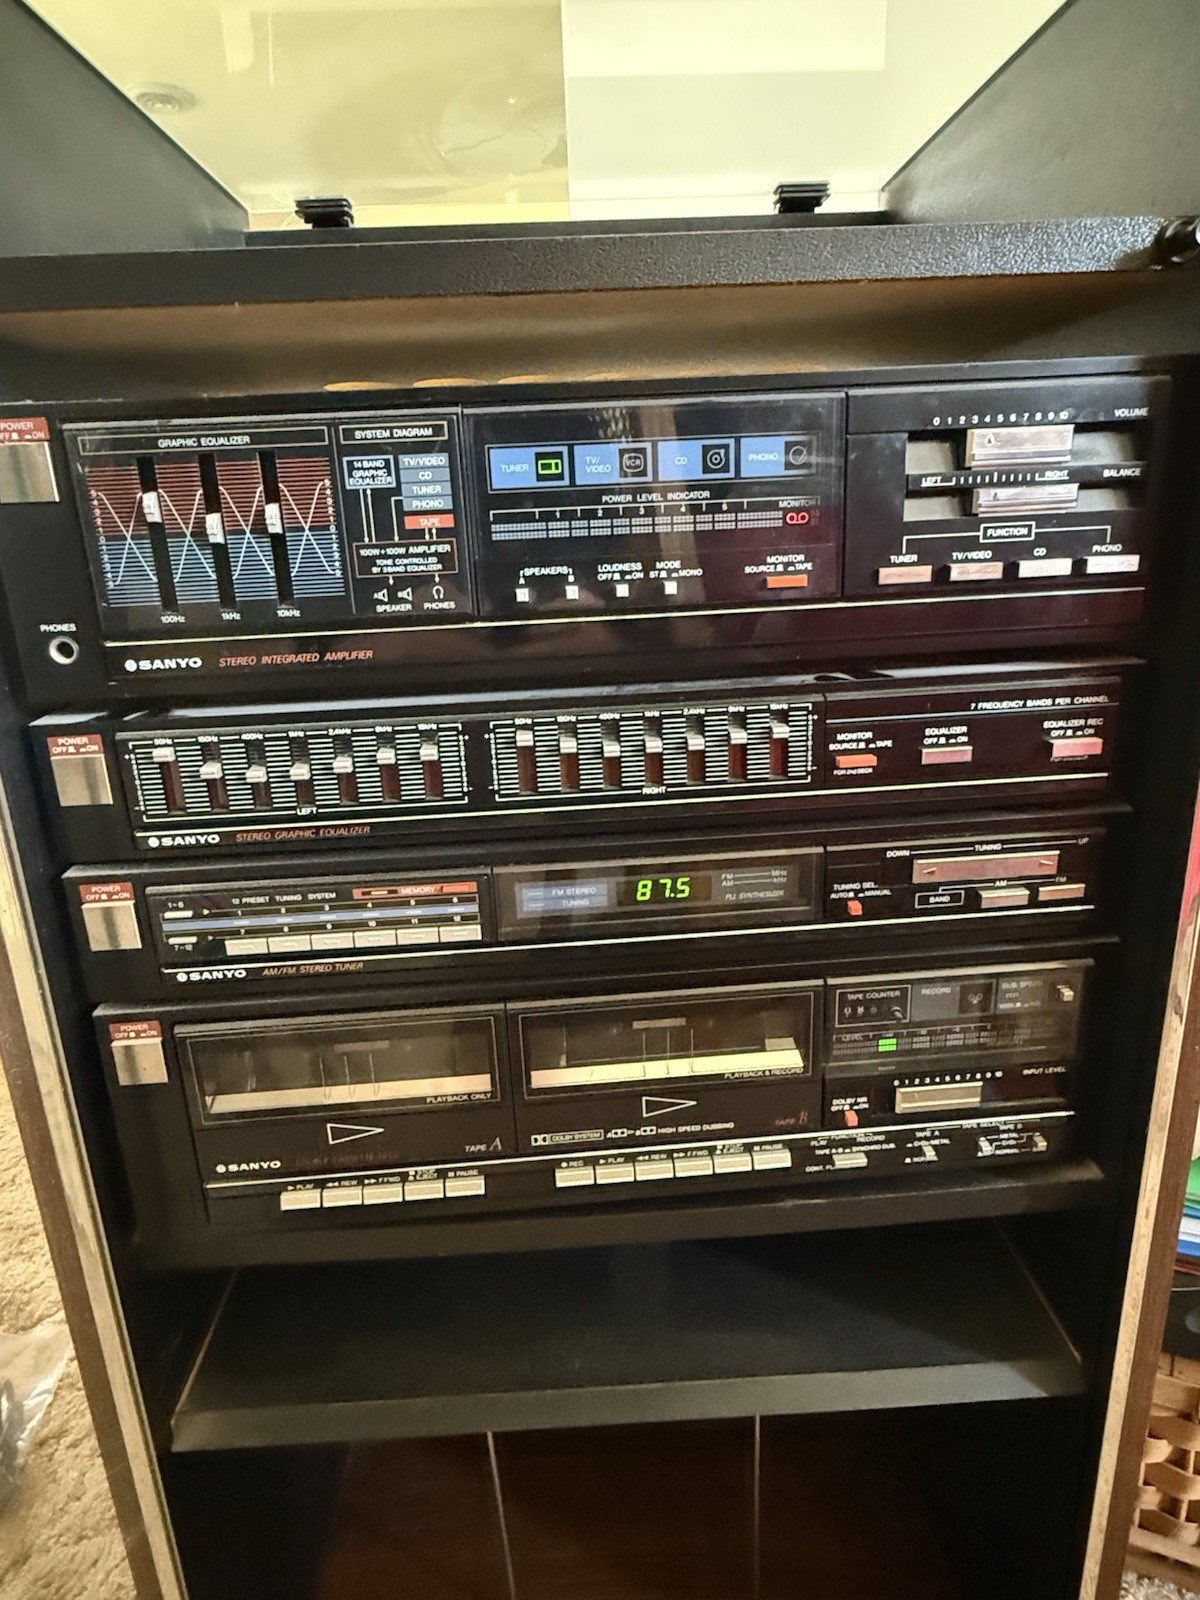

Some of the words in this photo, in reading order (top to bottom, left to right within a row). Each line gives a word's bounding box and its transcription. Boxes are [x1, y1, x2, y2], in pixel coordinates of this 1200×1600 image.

[1114, 407, 1149, 418] VOLUME
[934, 416, 940, 426] 0
[960, 416, 966, 425] 2
[972, 415, 978, 424] 3
[984, 414, 991, 424] 4
[996, 414, 1004, 424] 5
[1010, 413, 1016, 422] 6
[1022, 412, 1029, 422] 7
[1035, 412, 1042, 421] 8
[1048, 412, 1054, 420] 9
[1059, 411, 1069, 420] 10
[0, 422, 34, 431] POWER
[0, 432, 10, 440] FF
[32, 431, 46, 440] ON
[354, 429, 390, 440] SYSTEM
[393, 426, 433, 438] DIAGRAM
[158, 437, 198, 448] GRAPHIC
[200, 435, 250, 447] EQUALIZER
[403, 456, 446, 466] TV/VIDEO
[586, 456, 600, 466] TV/
[675, 456, 688, 465] CD
[748, 452, 779, 462] PHONO
[362, 460, 386, 468] BAND
[500, 463, 530, 474] TUNER
[586, 464, 612, 474] VIDEO
[352, 469, 388, 478] GRAPHIC
[418, 470, 432, 480] CD
[1102, 468, 1142, 478] BALANCE
[350, 476, 392, 485] EQUALIZER
[922, 476, 942, 486] LEFT
[412, 486, 442, 494] TUNER
[602, 493, 633, 504] POWER
[636, 492, 664, 502] LEVEL
[667, 490, 710, 501] INDICATOR
[412, 499, 444, 508] PHONO
[778, 499, 816, 508] MONITOR
[418, 518, 442, 526] TAPE
[986, 526, 1028, 538] FUNCTION
[408, 544, 451, 554] AMPLIFIER
[1034, 548, 1046, 556] CD
[1092, 544, 1122, 554] PHONO
[766, 554, 806, 564] MONITOR
[890, 554, 918, 564] TUNER
[952, 550, 992, 560] TV/VIDEO
[395, 556, 438, 565] CONTROLLED
[656, 560, 681, 570] MODE
[524, 566, 568, 576] SPEAKERS
[598, 562, 642, 573] LOUDNESS
[744, 564, 776, 574] SOURCE
[795, 562, 813, 572] TAPE
[598, 572, 613, 581] OFF
[632, 571, 644, 580] ON
[650, 570, 660, 579] ST
[678, 568, 703, 578] MONO
[376, 603, 412, 613] SPEAKER
[423, 601, 456, 610] PHONES
[222, 612, 241, 621] 1kHz
[276, 608, 301, 618] 10kHz
[160, 614, 186, 624] 100Hz
[40, 622, 76, 633] PHONES
[138, 656, 202, 670] SANYO
[218, 656, 256, 668] STEREO
[262, 652, 320, 665] INTEGRATED
[324, 649, 374, 662] AMPLIFIER
[978, 699, 1024, 710] FREQUENCY
[1026, 697, 1053, 708] BANDS
[1055, 697, 1072, 706] PER
[1074, 694, 1110, 705] CHANNEL
[1042, 718, 1086, 730] EQUALIZER
[1087, 717, 1104, 726] REC
[836, 731, 873, 741] MONITOR
[925, 726, 968, 736] EQUALIZER
[1050, 730, 1064, 738] OFF
[1084, 728, 1095, 736] ON
[58, 737, 90, 746] POWER
[924, 736, 938, 744] OFF
[956, 735, 968, 744] ON
[52, 746, 66, 754] OFF
[86, 744, 99, 752] ON
[828, 741, 858, 751] SOURCE
[876, 740, 892, 748] TAPE
[642, 786, 667, 795] RIGHT
[296, 807, 317, 816] LEFT
[236, 831, 272, 842] STEREO
[275, 828, 316, 840] GRAPHIC
[318, 825, 370, 838] EQUALIZER
[160, 834, 221, 847] SANYO
[1078, 837, 1090, 845] UP
[886, 850, 910, 858] DOWN
[91, 885, 121, 893] POWER
[401, 886, 436, 895] MEMORY
[566, 886, 596, 896] STEREO
[636, 876, 691, 902] 87.5
[242, 896, 270, 904] PRESET
[275, 894, 302, 903] TUNING
[308, 892, 336, 900] SYSTEM
[738, 890, 784, 900] SYNTHESIZER
[830, 892, 848, 900] AUTO
[864, 889, 892, 897] MANUAL
[929, 895, 950, 904] BAND
[562, 898, 590, 907] TUNING
[262, 966, 296, 976] AM/FM
[300, 964, 332, 974] STEREO
[334, 962, 364, 972] TUNER
[188, 968, 248, 981] SANYO
[866, 990, 900, 999] COUNTER
[922, 987, 951, 995] RECORD
[120, 1024, 150, 1032] POWER
[146, 1029, 158, 1037] ON
[724, 1070, 764, 1080] PLAYBACK
[770, 1067, 804, 1076] RECORD
[426, 1094, 469, 1104] PLAYBACK
[470, 1092, 492, 1101] ONLY
[832, 1098, 855, 1106] DOLBY
[658, 1126, 676, 1134] HIGH
[678, 1124, 702, 1133] SPEED
[702, 1122, 734, 1130] DUBBING
[464, 1143, 487, 1153] TAPE
[488, 1136, 502, 1150] A
[228, 1159, 282, 1171] SANYO
